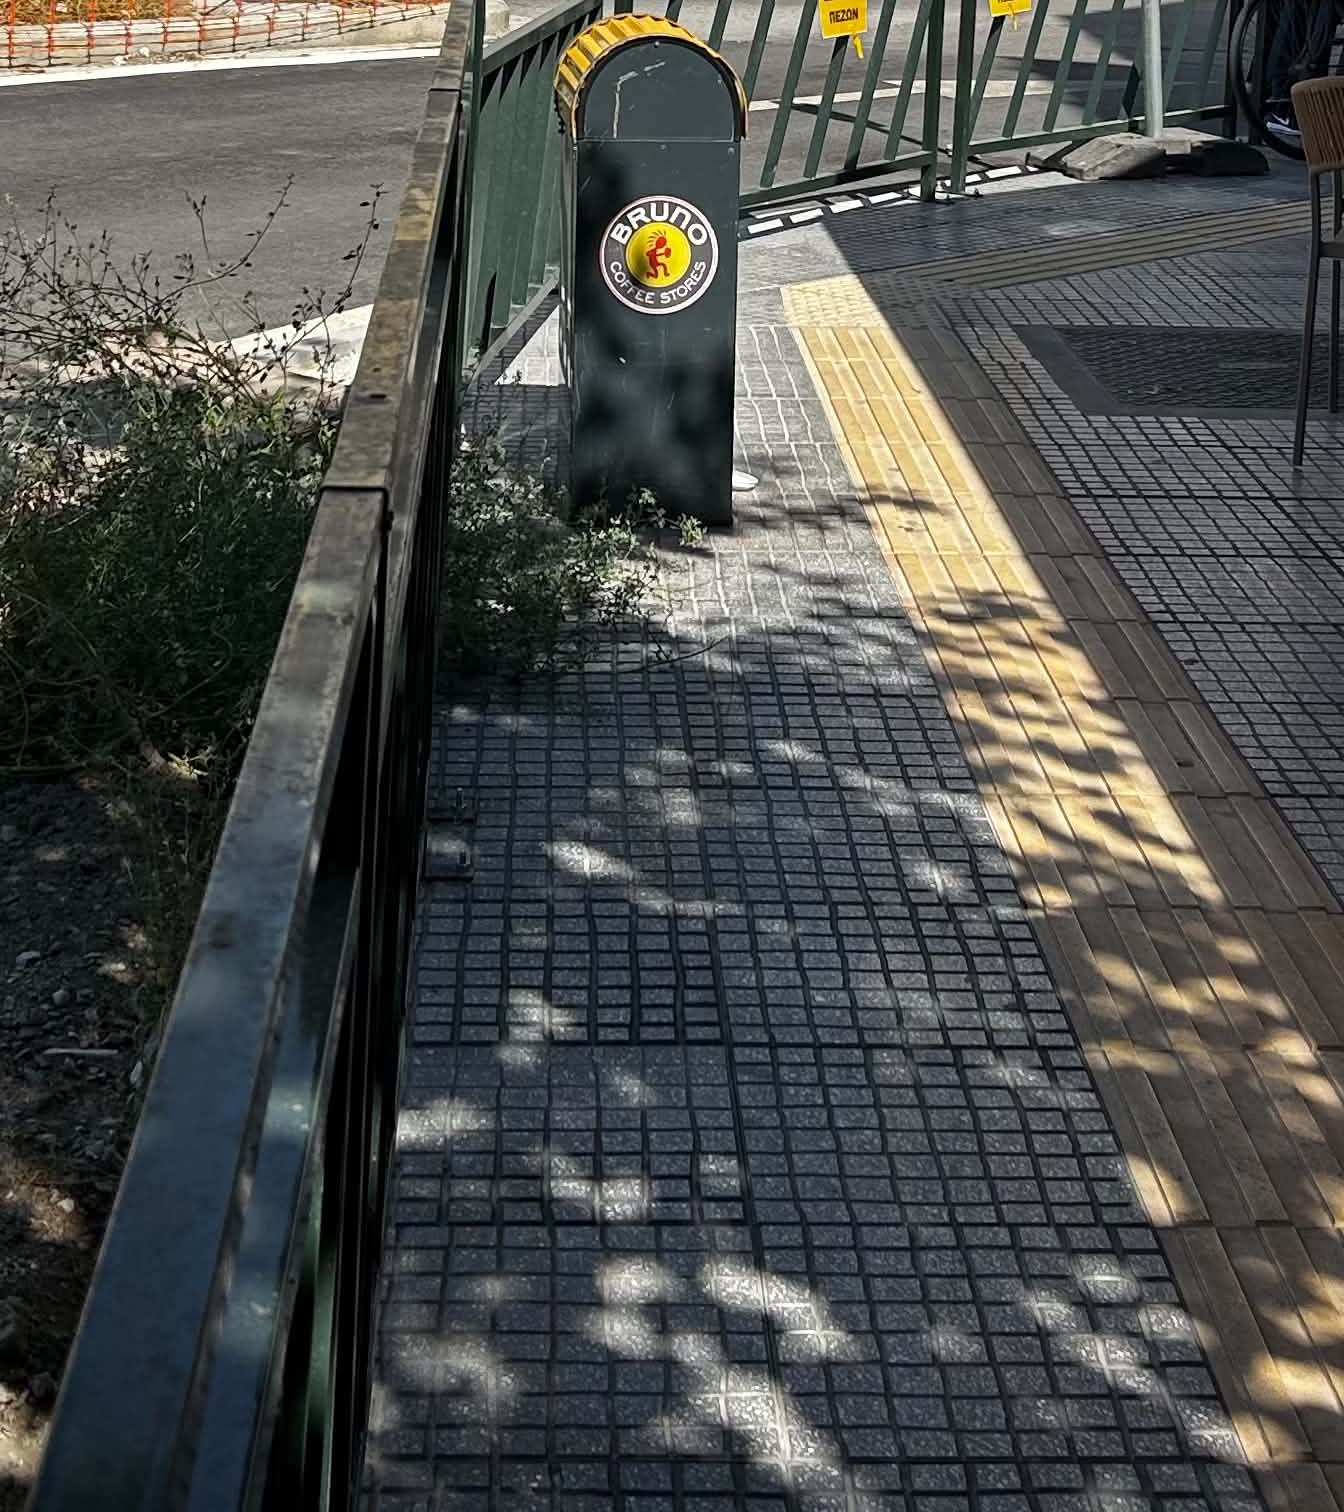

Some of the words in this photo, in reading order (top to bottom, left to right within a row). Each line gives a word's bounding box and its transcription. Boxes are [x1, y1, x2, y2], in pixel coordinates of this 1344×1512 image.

[829, 7, 859, 25] ΠΕΖΩΝ
[609, 202, 709, 246] BRUNO
[610, 261, 655, 304] COFFEE
[660, 261, 706, 304] STORES
